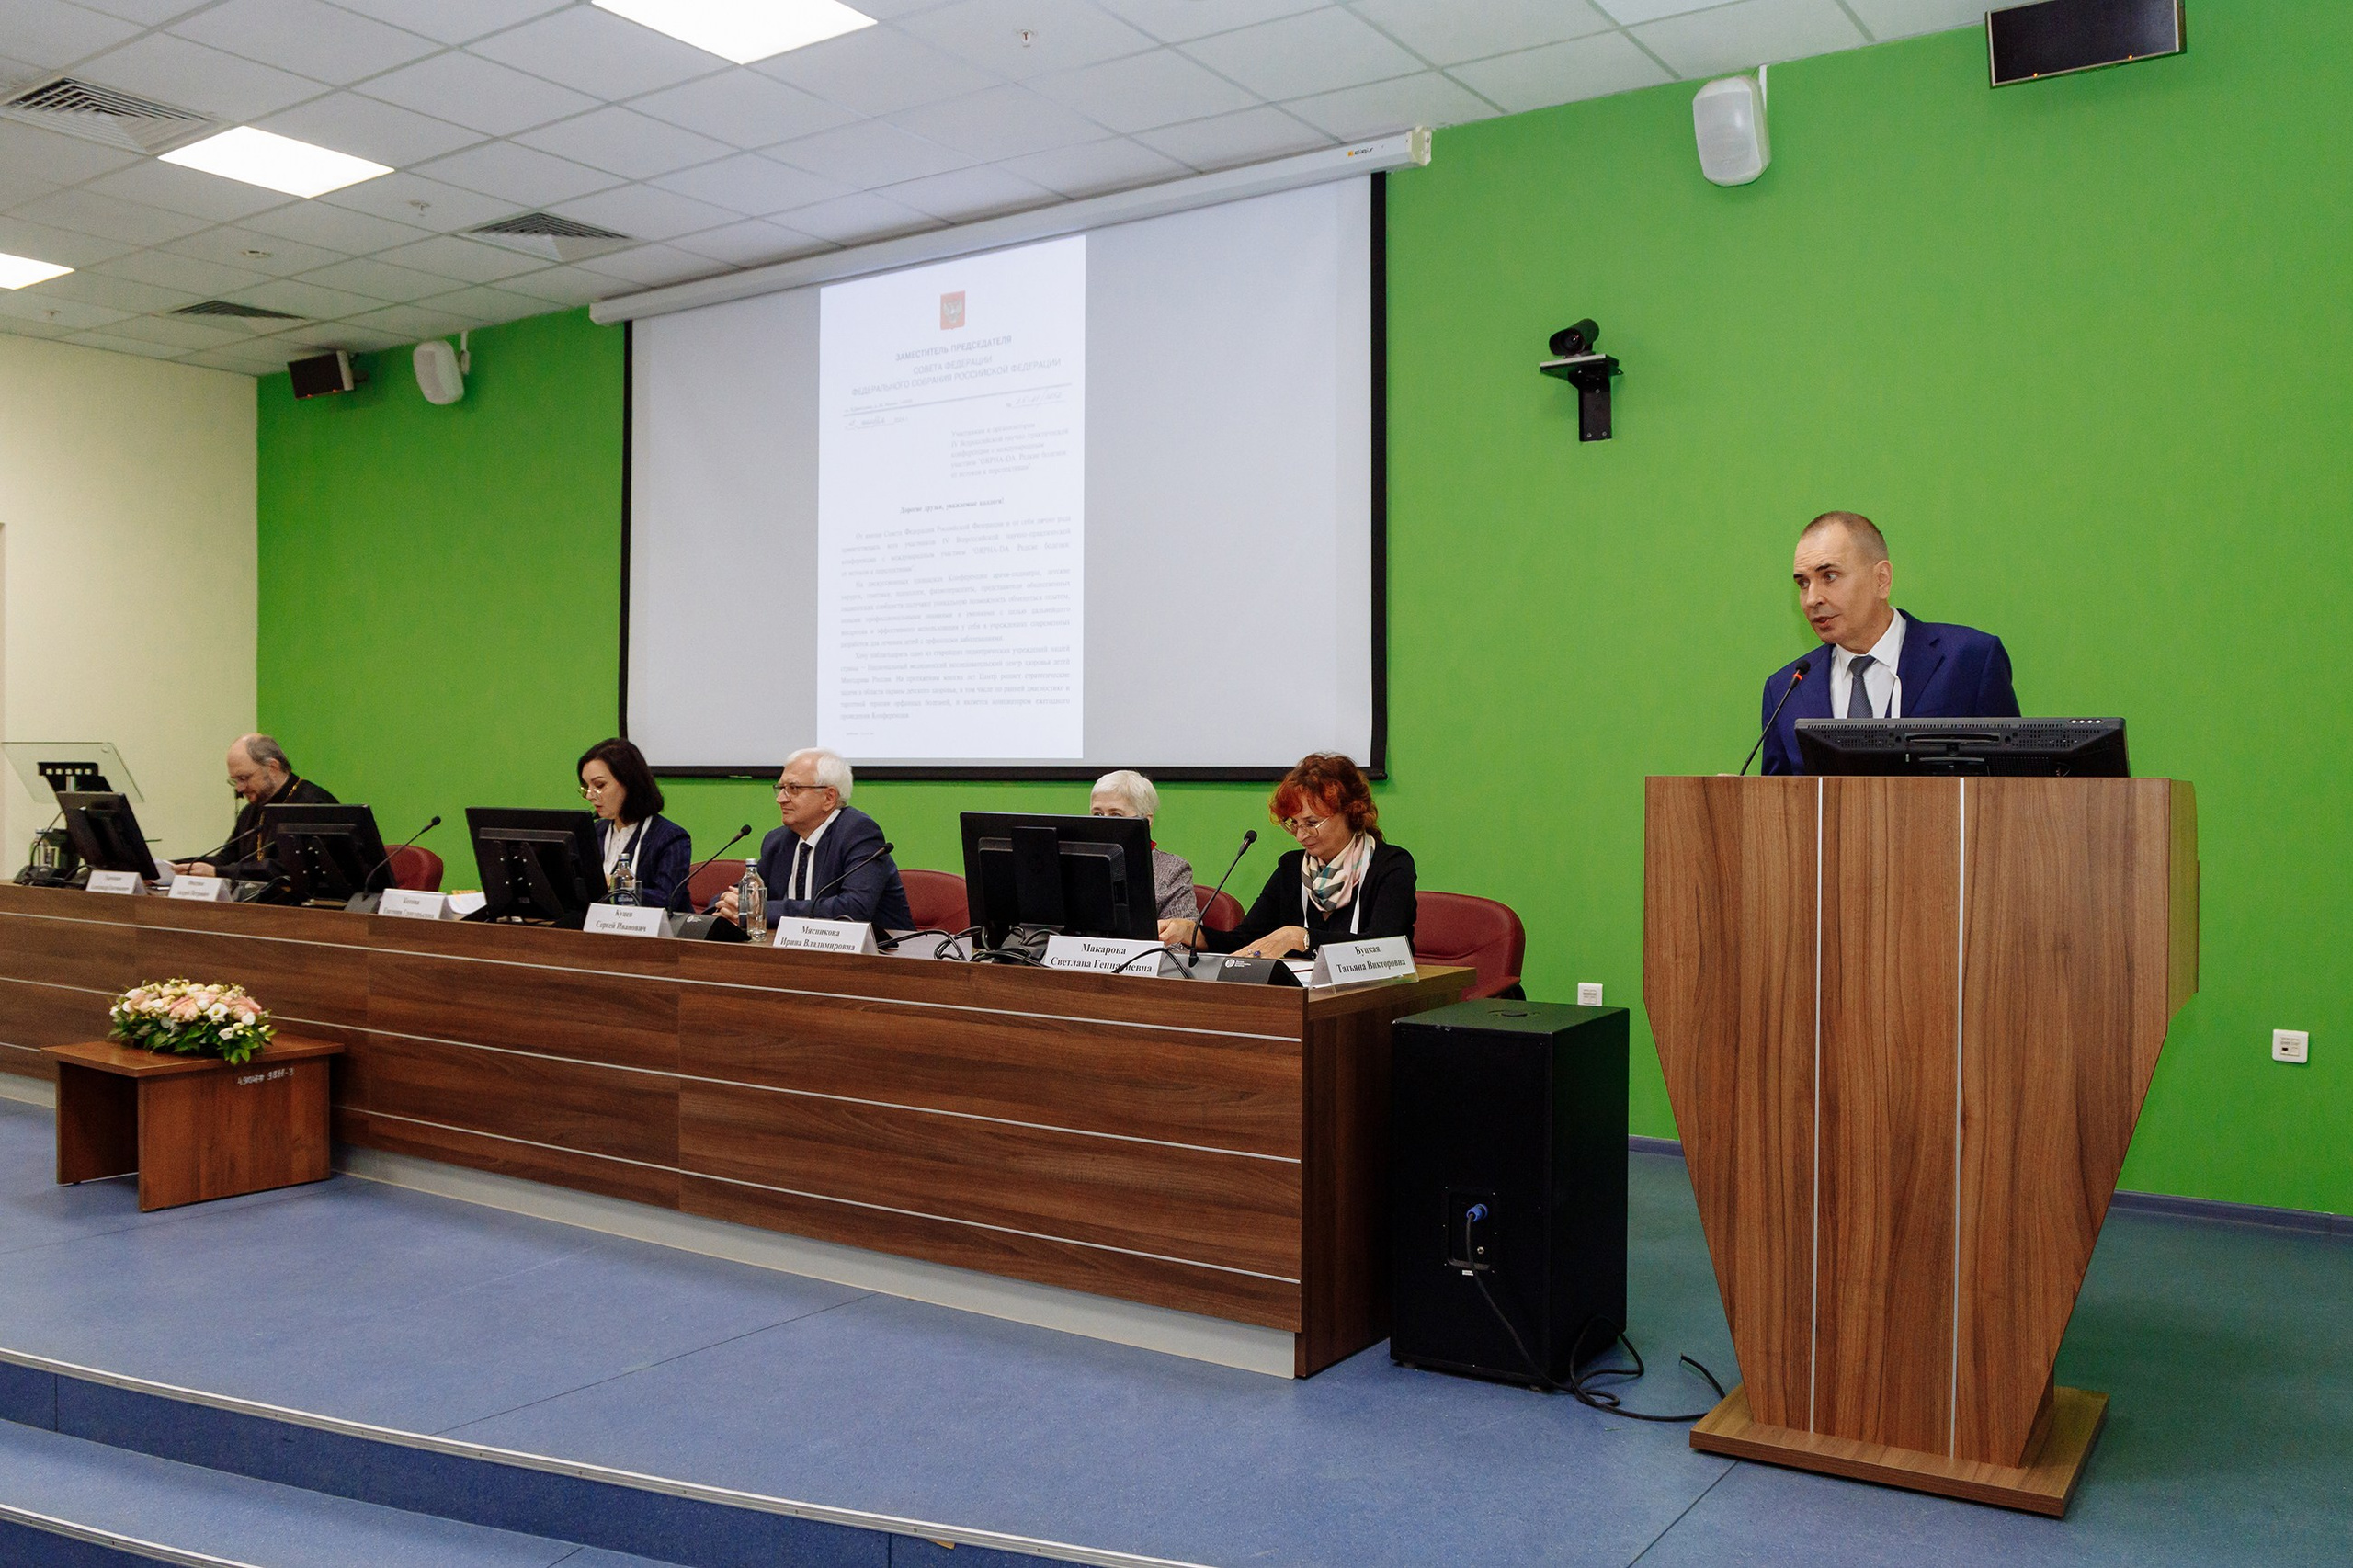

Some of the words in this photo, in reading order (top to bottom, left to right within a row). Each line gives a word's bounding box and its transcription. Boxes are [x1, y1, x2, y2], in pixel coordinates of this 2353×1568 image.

[895, 346, 949, 361] ЗАМЕСТИТЕЛЬ
[950, 335, 1012, 353] ПРЕДСЕДАТЕЛЯ
[913, 363, 942, 375] СОВЕТА
[944, 355, 993, 370] ФЕДЕРАЦИИ
[851, 379, 910, 395] ФЕДЕРАЛЬНОГО
[912, 374, 952, 387] СОБРАНИЯ
[954, 364, 1009, 381] РОССИЙСКОЙ
[1011, 358, 1062, 372] ФЕДЕРАЦИИ
[596, 920, 616, 930] Сергей
[616, 922, 647, 932] Иванович
[801, 926, 841, 937] Мясникова
[780, 937, 802, 948] Ирина
[803, 938, 856, 951] Владимировна
[1081, 943, 1127, 956] Макарова
[1355, 945, 1381, 957] Буцкая
[1051, 956, 1092, 968] Светлана
[1093, 959, 1153, 972] Геннаиевна
[1336, 963, 1367, 973] Татьяна
[1367, 959, 1406, 970] Викторовна
